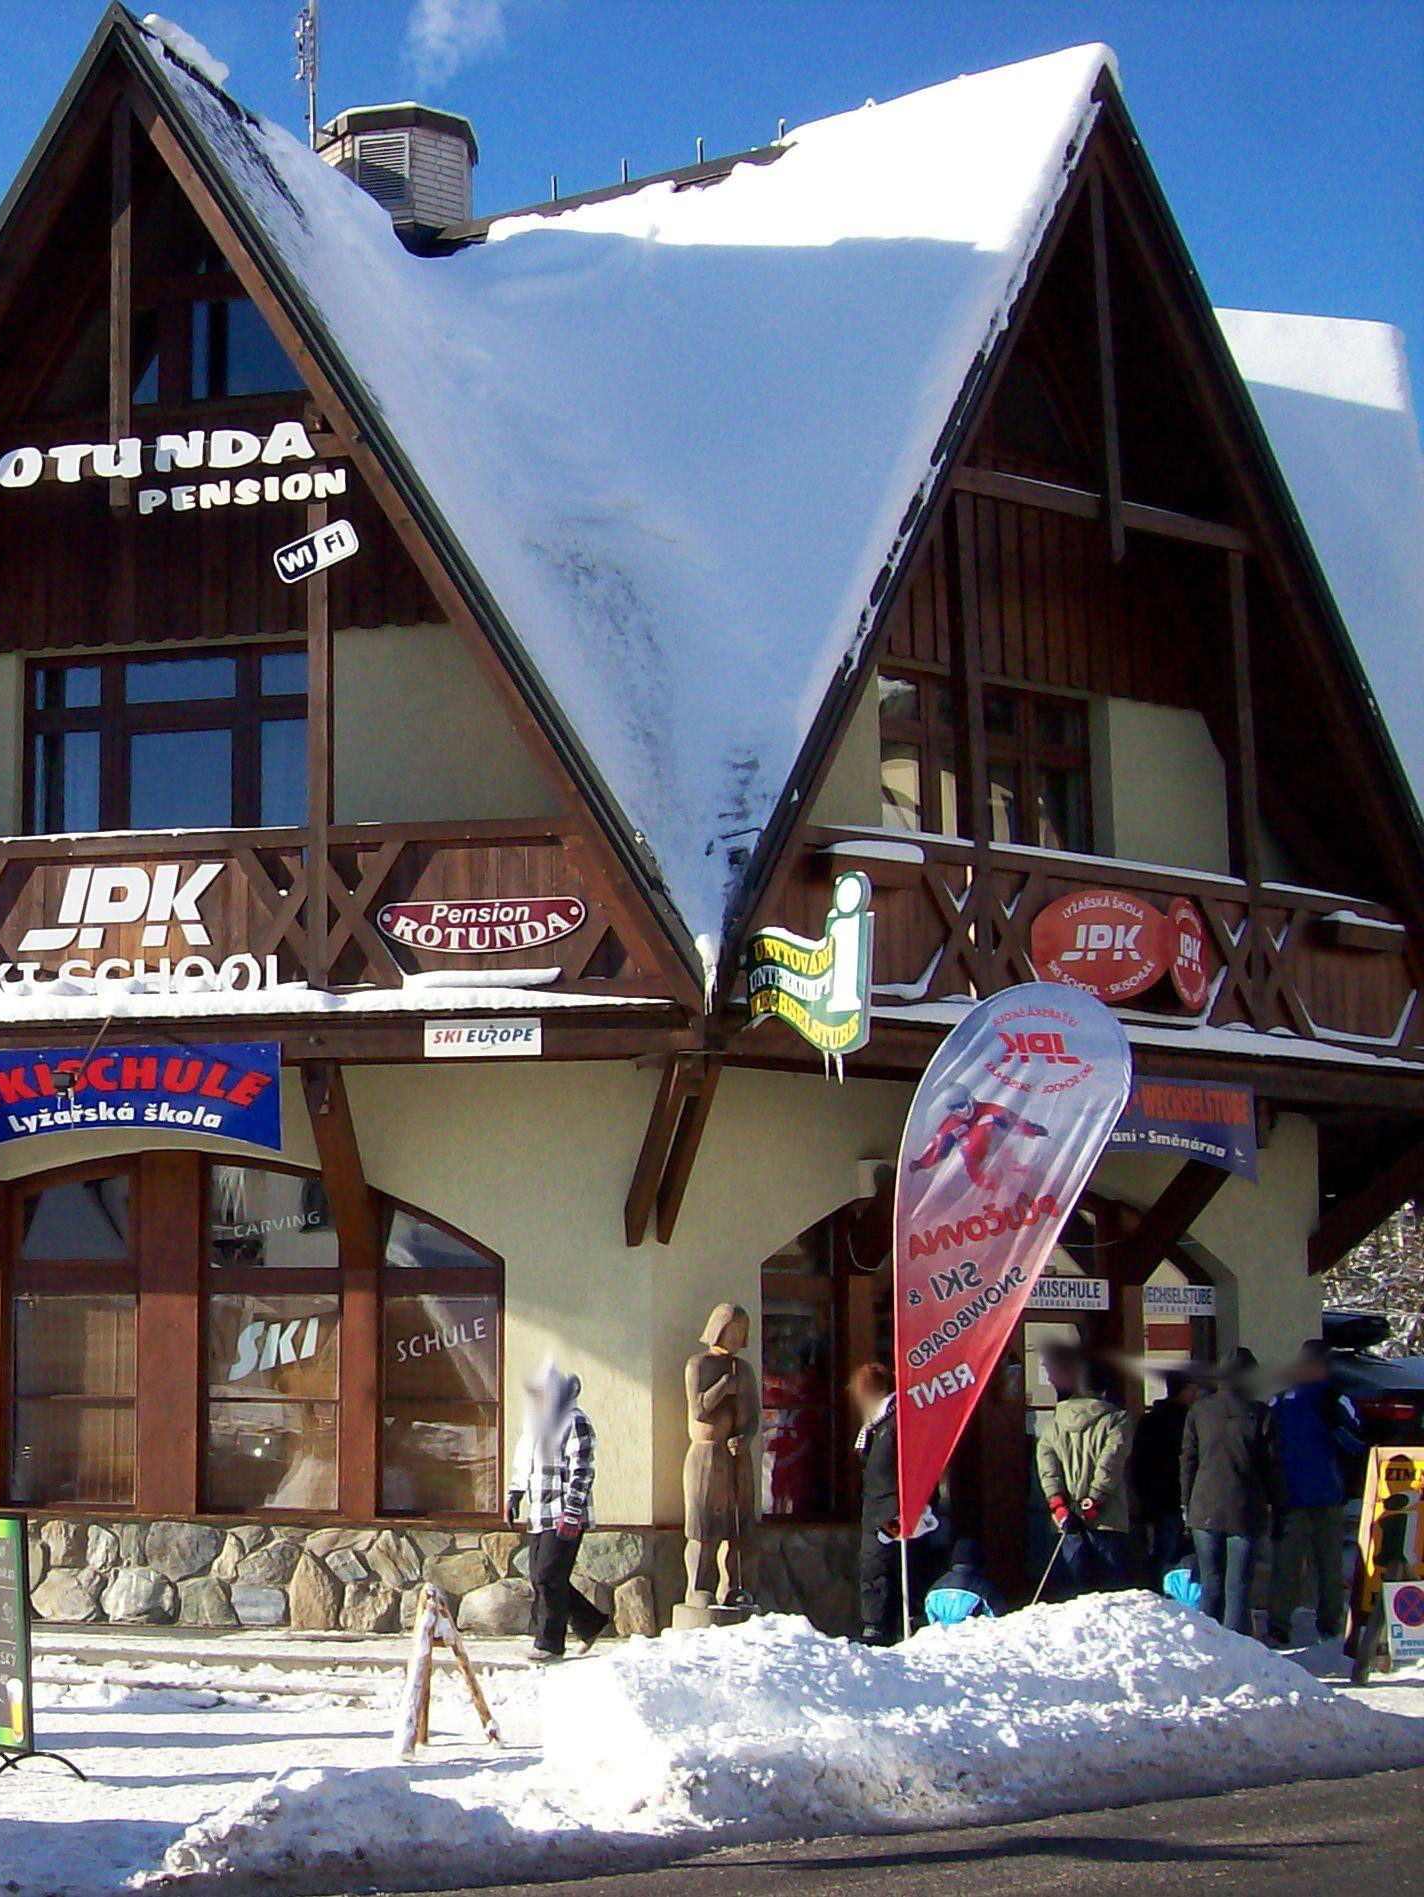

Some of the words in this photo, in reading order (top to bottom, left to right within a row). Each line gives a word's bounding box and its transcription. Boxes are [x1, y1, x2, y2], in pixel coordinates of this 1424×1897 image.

[138, 468, 347, 515] PENSION
[18, 862, 226, 952] JPK
[431, 902, 530, 926] Pension
[392, 911, 572, 950] ROTUNDA
[1060, 924, 1143, 962] JPK
[433, 1030, 462, 1044] SKI
[466, 1026, 534, 1045] EUROPE
[7, 1100, 136, 1134] Lyžařská
[143, 1101, 223, 1129] škola
[233, 1210, 321, 1238] CARVING
[1143, 1286, 1213, 1305] ECHSELSTUBE
[228, 1317, 320, 1381] SKI
[396, 1317, 488, 1363] SCHULE
